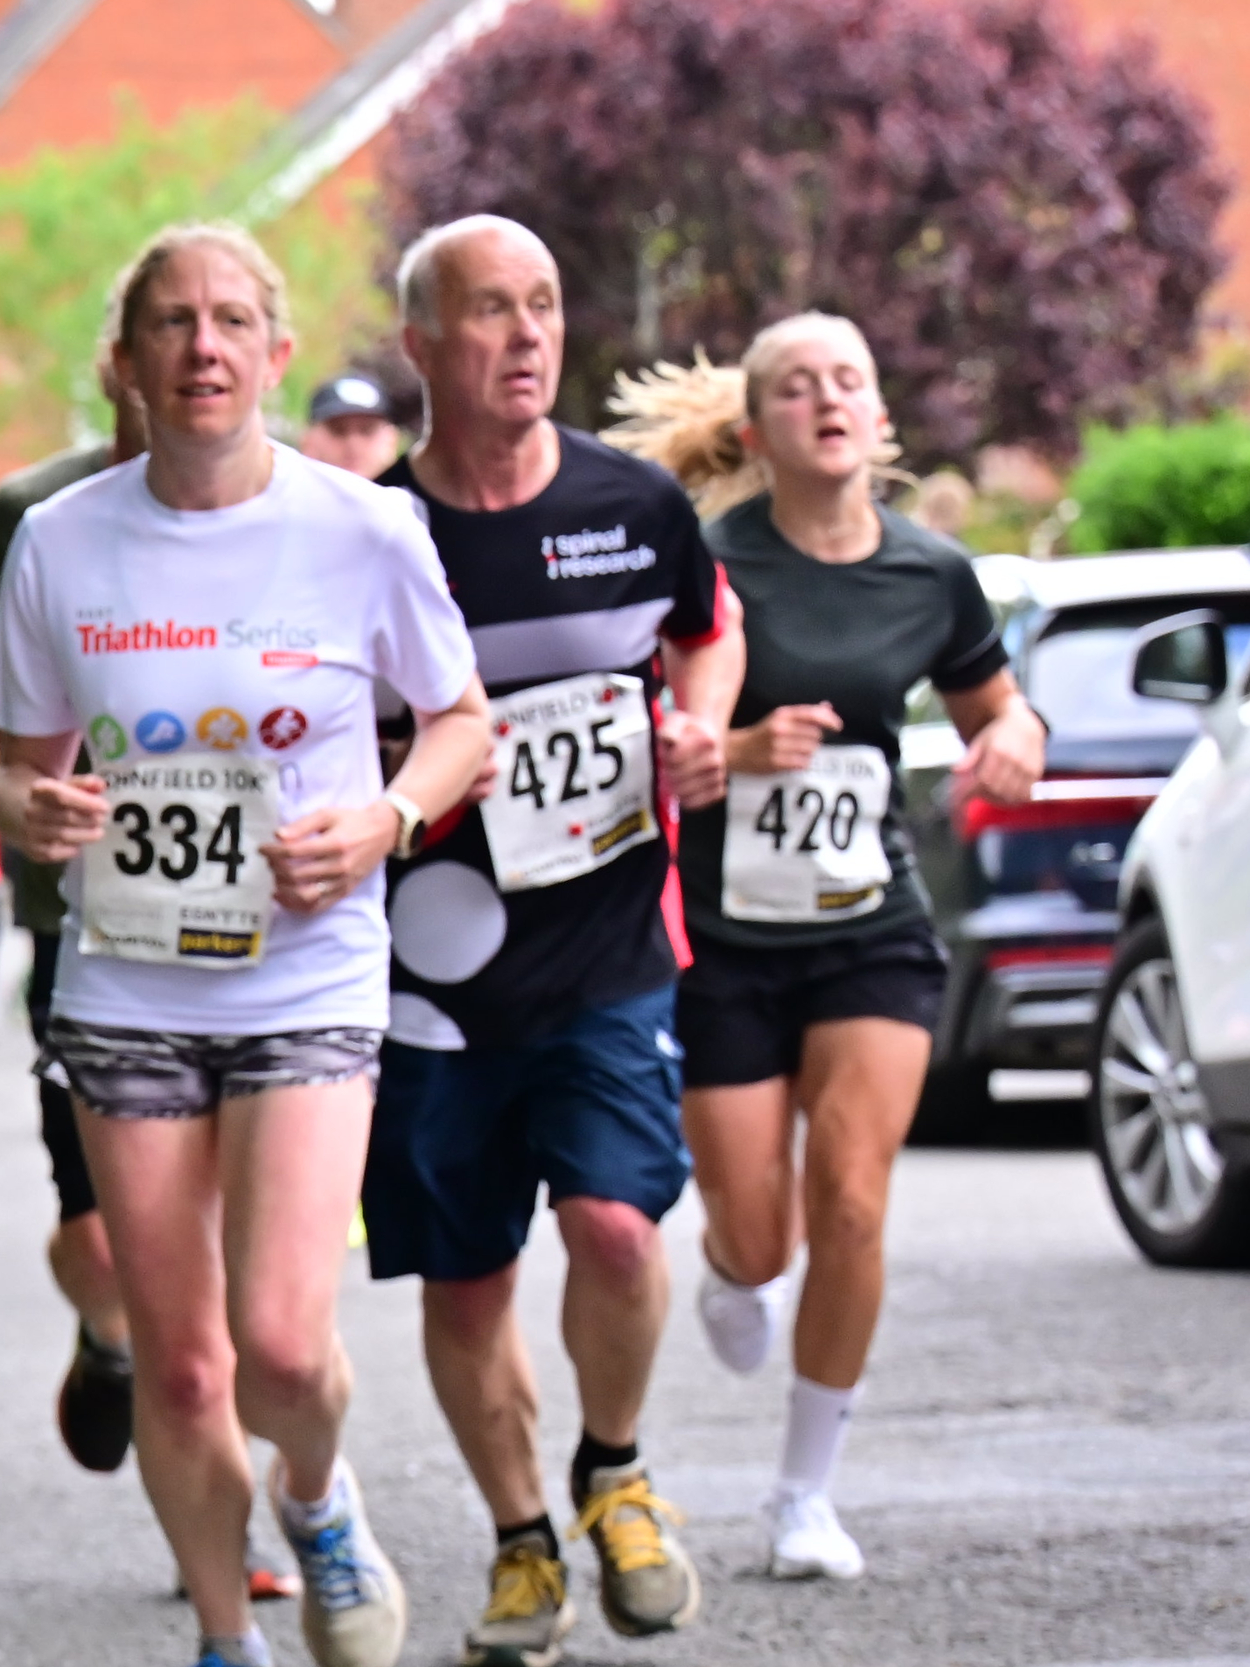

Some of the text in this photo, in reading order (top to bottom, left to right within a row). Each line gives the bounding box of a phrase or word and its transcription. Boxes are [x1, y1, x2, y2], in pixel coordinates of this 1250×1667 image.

[555, 524, 627, 559] spinal
[559, 544, 657, 579] research
[77, 618, 318, 654] Triathlon Series
[511, 717, 624, 809] 425
[112, 802, 245, 884] 334
[755, 786, 858, 851] 420
